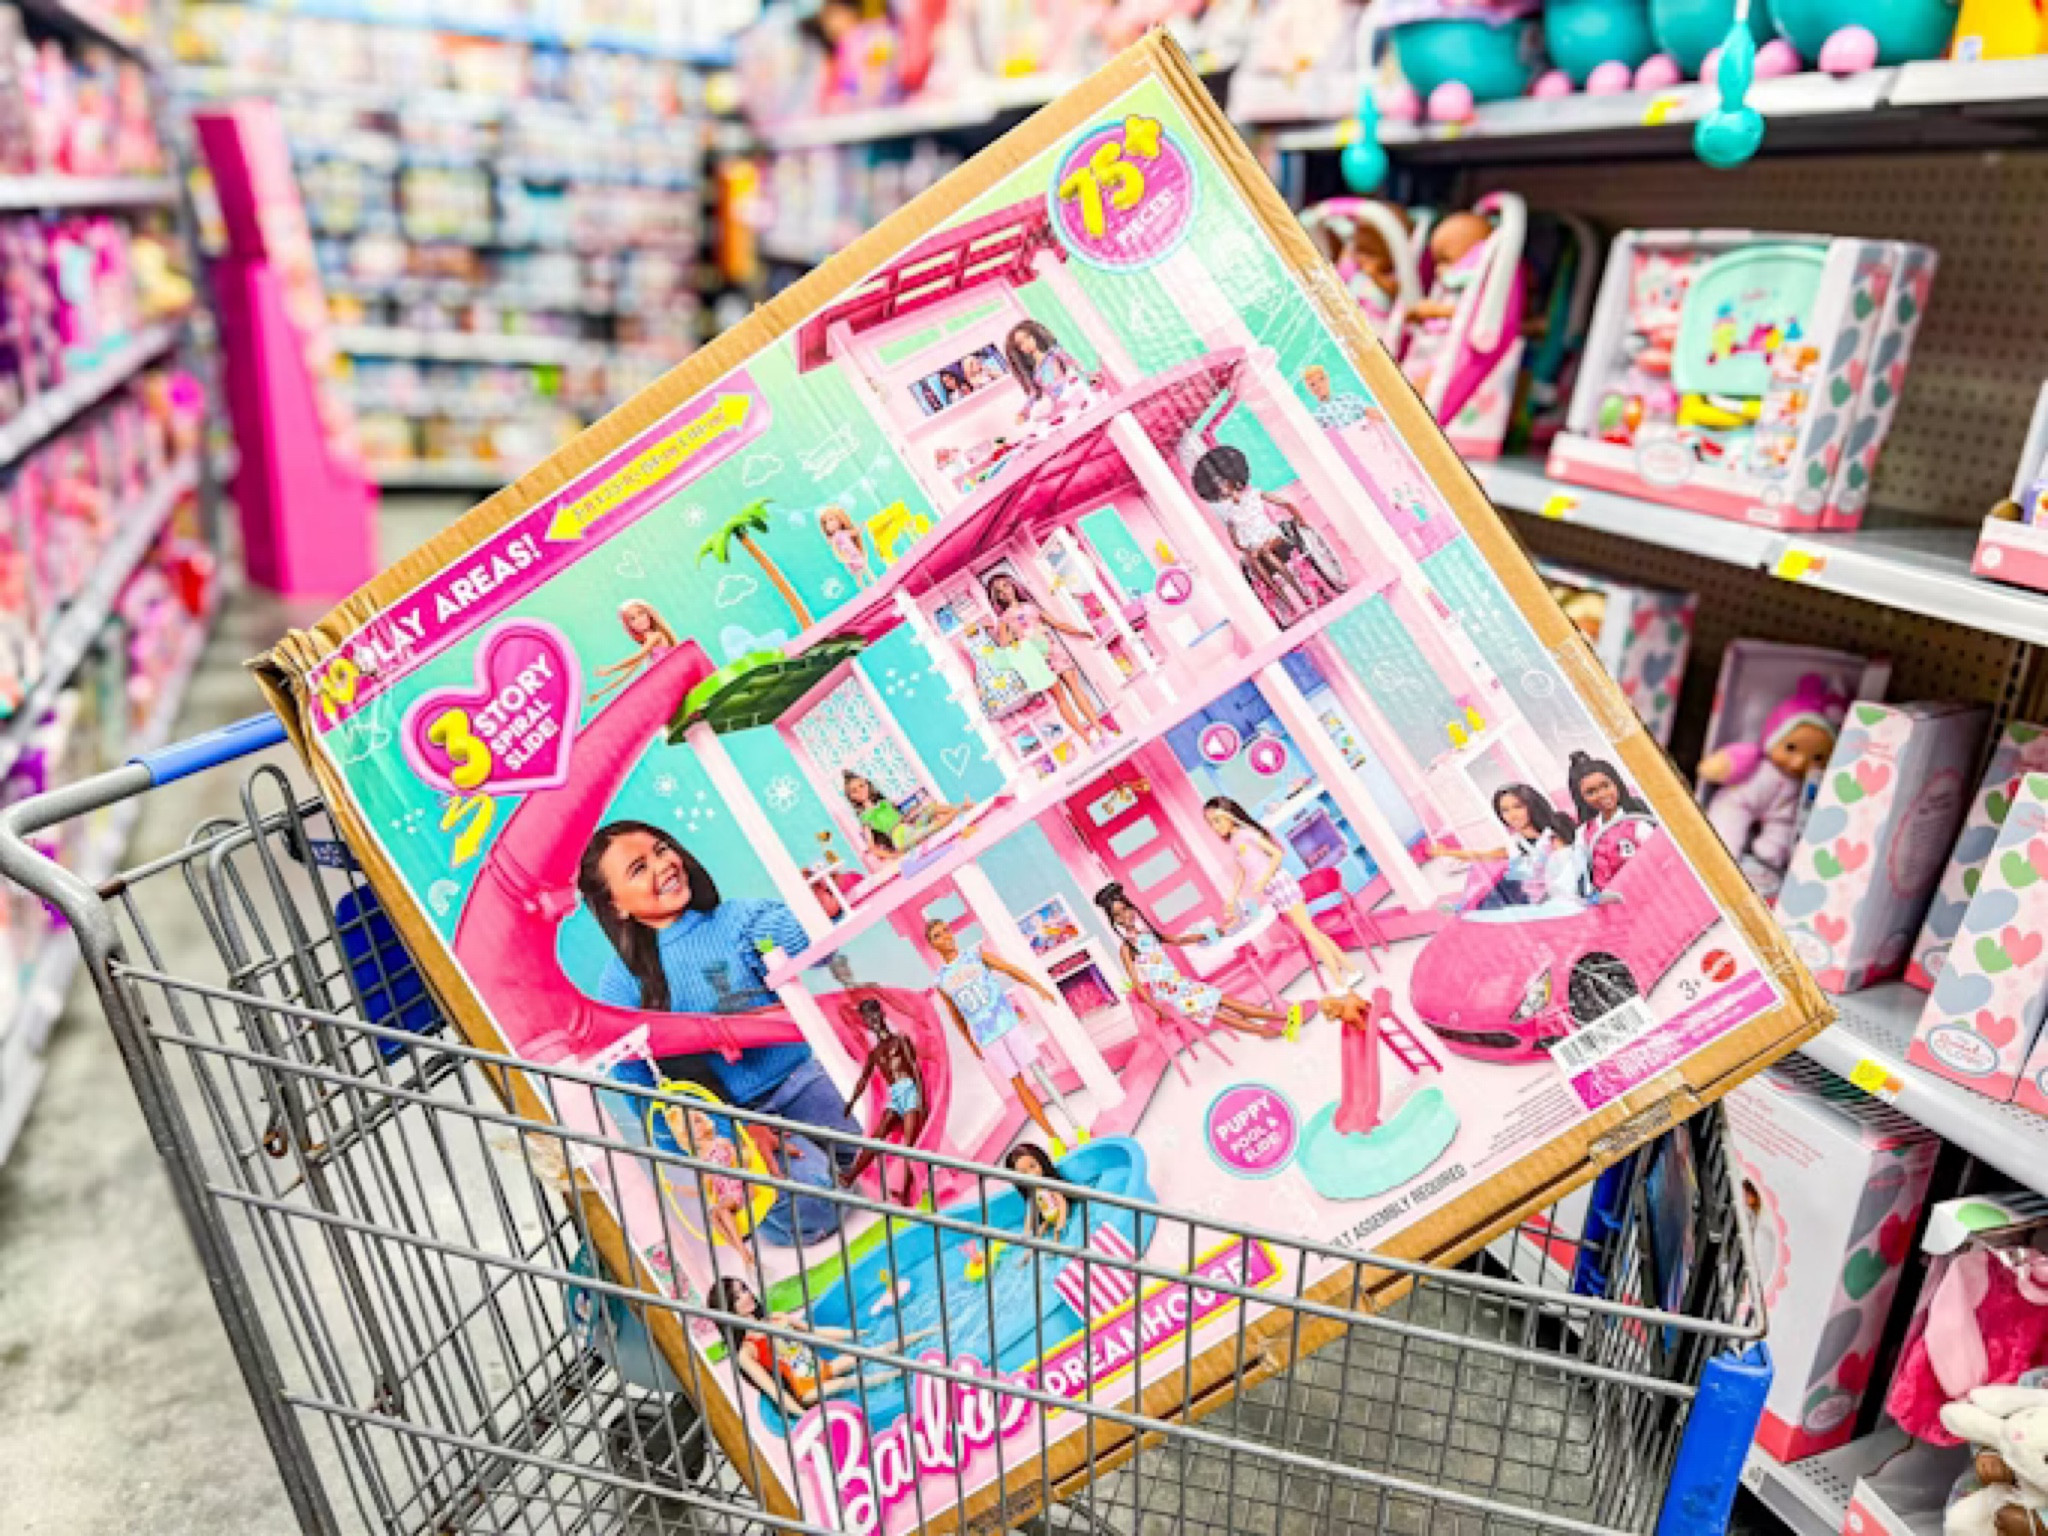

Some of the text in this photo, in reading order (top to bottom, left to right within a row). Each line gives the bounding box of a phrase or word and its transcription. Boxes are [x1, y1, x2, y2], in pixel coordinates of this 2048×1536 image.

[433, 532, 543, 624] AREAS!
[428, 653, 555, 790] 3 STORY
[490, 699, 552, 755] SPIRAL
[1216, 1095, 1271, 1142] PUPPY
[1230, 1125, 1267, 1155] POOL
[1352, 1194, 1411, 1240] ASSEMBLY
[1410, 1163, 1468, 1204] REQUIRED
[794, 1356, 1034, 1536] Barbie
